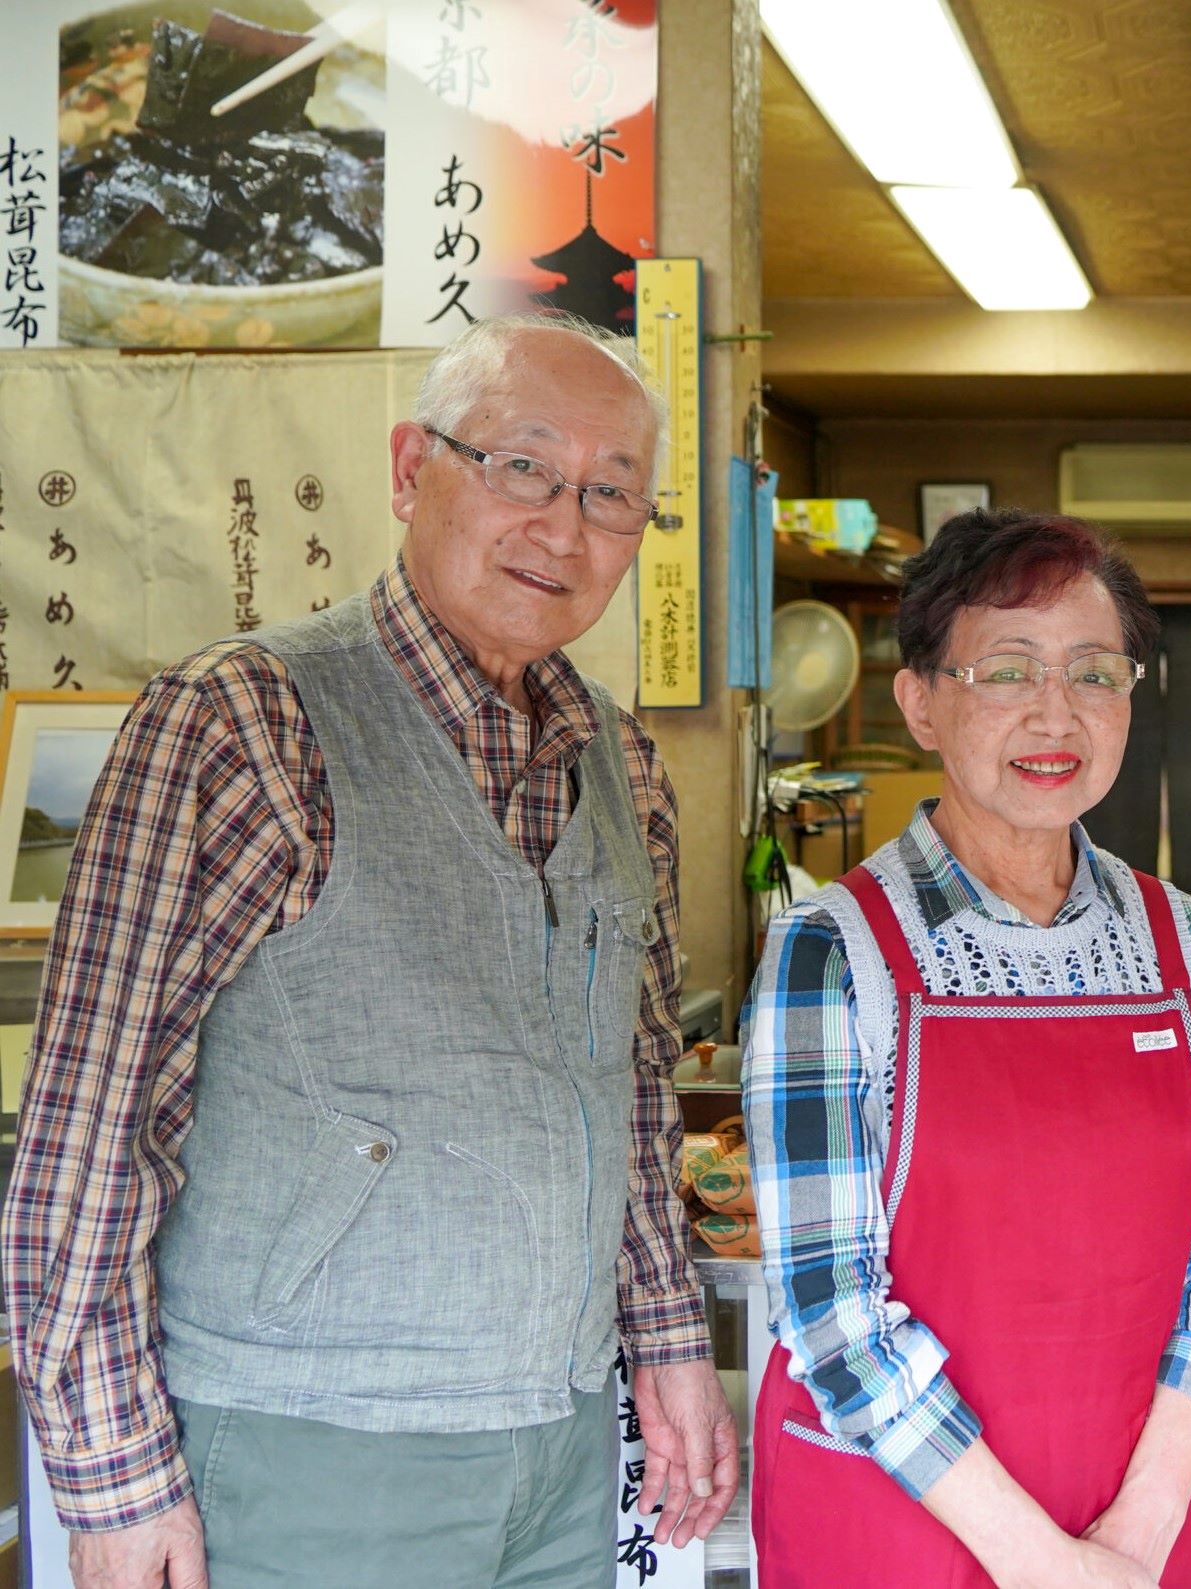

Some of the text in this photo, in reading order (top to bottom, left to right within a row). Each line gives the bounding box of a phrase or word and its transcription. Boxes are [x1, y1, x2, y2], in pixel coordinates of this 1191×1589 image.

[0, 136, 46, 348] 松茸昆布
[424, 153, 483, 325] あめ久
